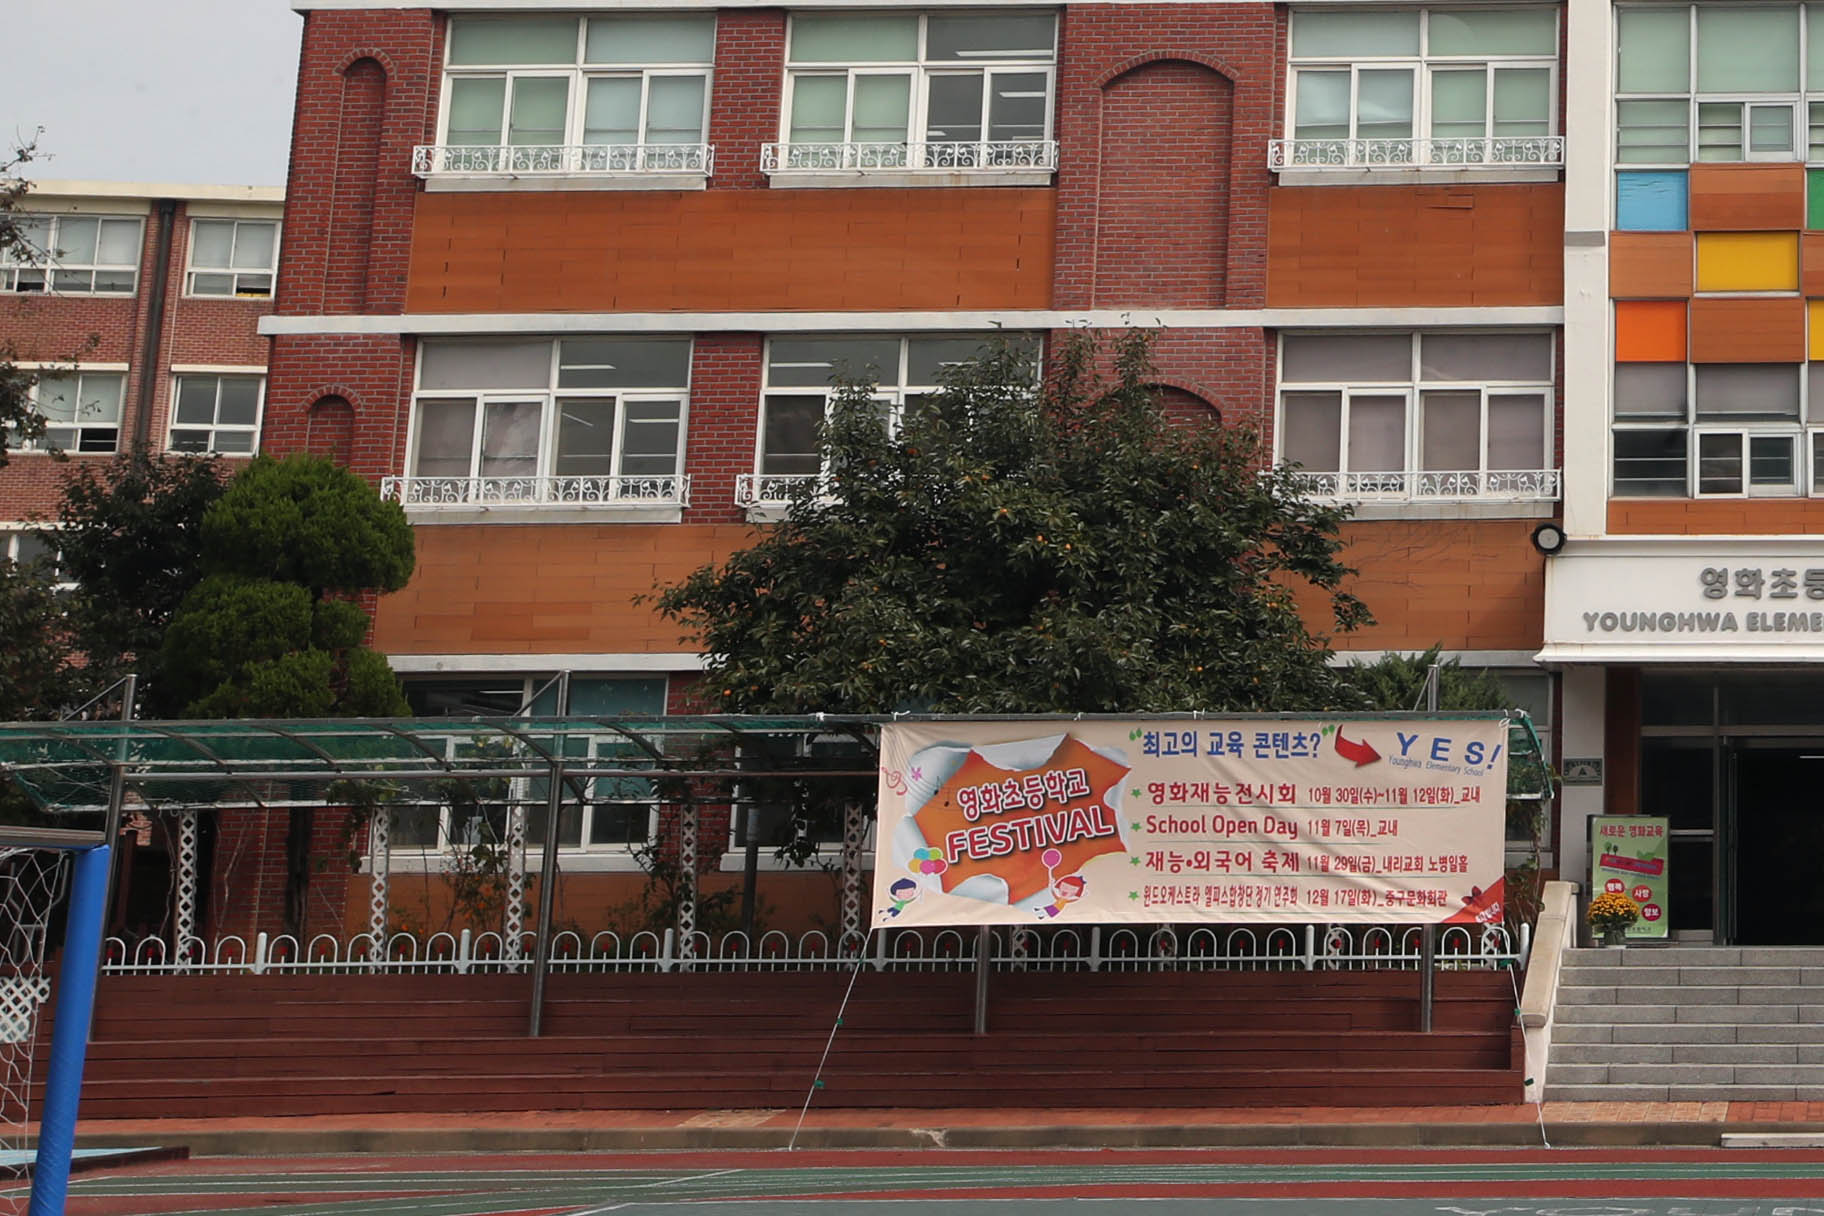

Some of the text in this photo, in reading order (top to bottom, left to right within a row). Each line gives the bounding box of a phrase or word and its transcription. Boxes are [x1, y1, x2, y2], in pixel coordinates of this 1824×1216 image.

[1582, 611, 1739, 633] YOUNGHWA
[1207, 731, 1245, 759] 교육
[1396, 732, 1502, 770] YES!
[1389, 754, 1485, 777] Younghwa Elementary School
[957, 768, 1091, 821] 영화초등학교
[1147, 782, 1296, 805] 영화재능전시회
[1308, 787, 1331, 805] 10월
[946, 805, 1114, 863] FESTIVAL
[1146, 815, 1207, 834] School
[1212, 815, 1258, 838] Open
[1264, 816, 1298, 840] Day
[1308, 819, 1330, 837] 11월
[1261, 849, 1299, 873] 축제
[1307, 855, 1330, 873] 11월
[1307, 887, 1330, 906] 12월
